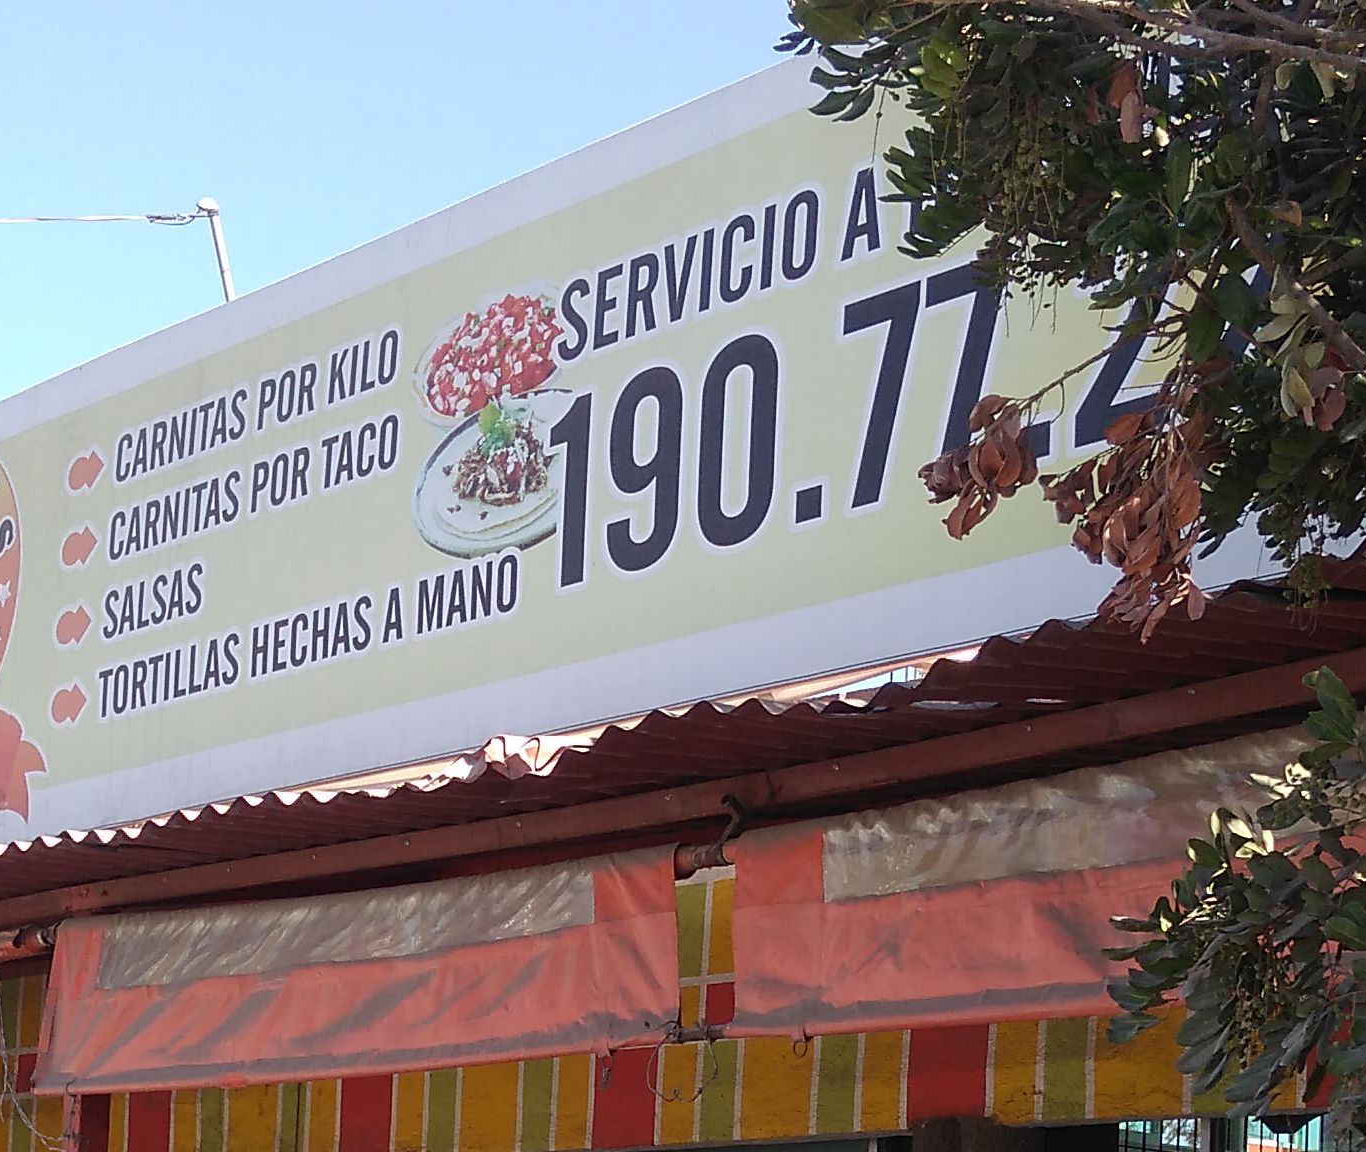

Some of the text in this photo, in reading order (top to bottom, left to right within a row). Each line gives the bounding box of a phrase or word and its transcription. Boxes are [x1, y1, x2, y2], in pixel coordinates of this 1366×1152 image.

[558, 167, 881, 361] SERVICIO A
[115, 330, 399, 483] CARNITAS POR KILO
[110, 414, 399, 561] CARNITAS POR TACO
[99, 554, 518, 717] TORTILLAS HECHAS A MANO
[103, 563, 203, 640] SALSAS
